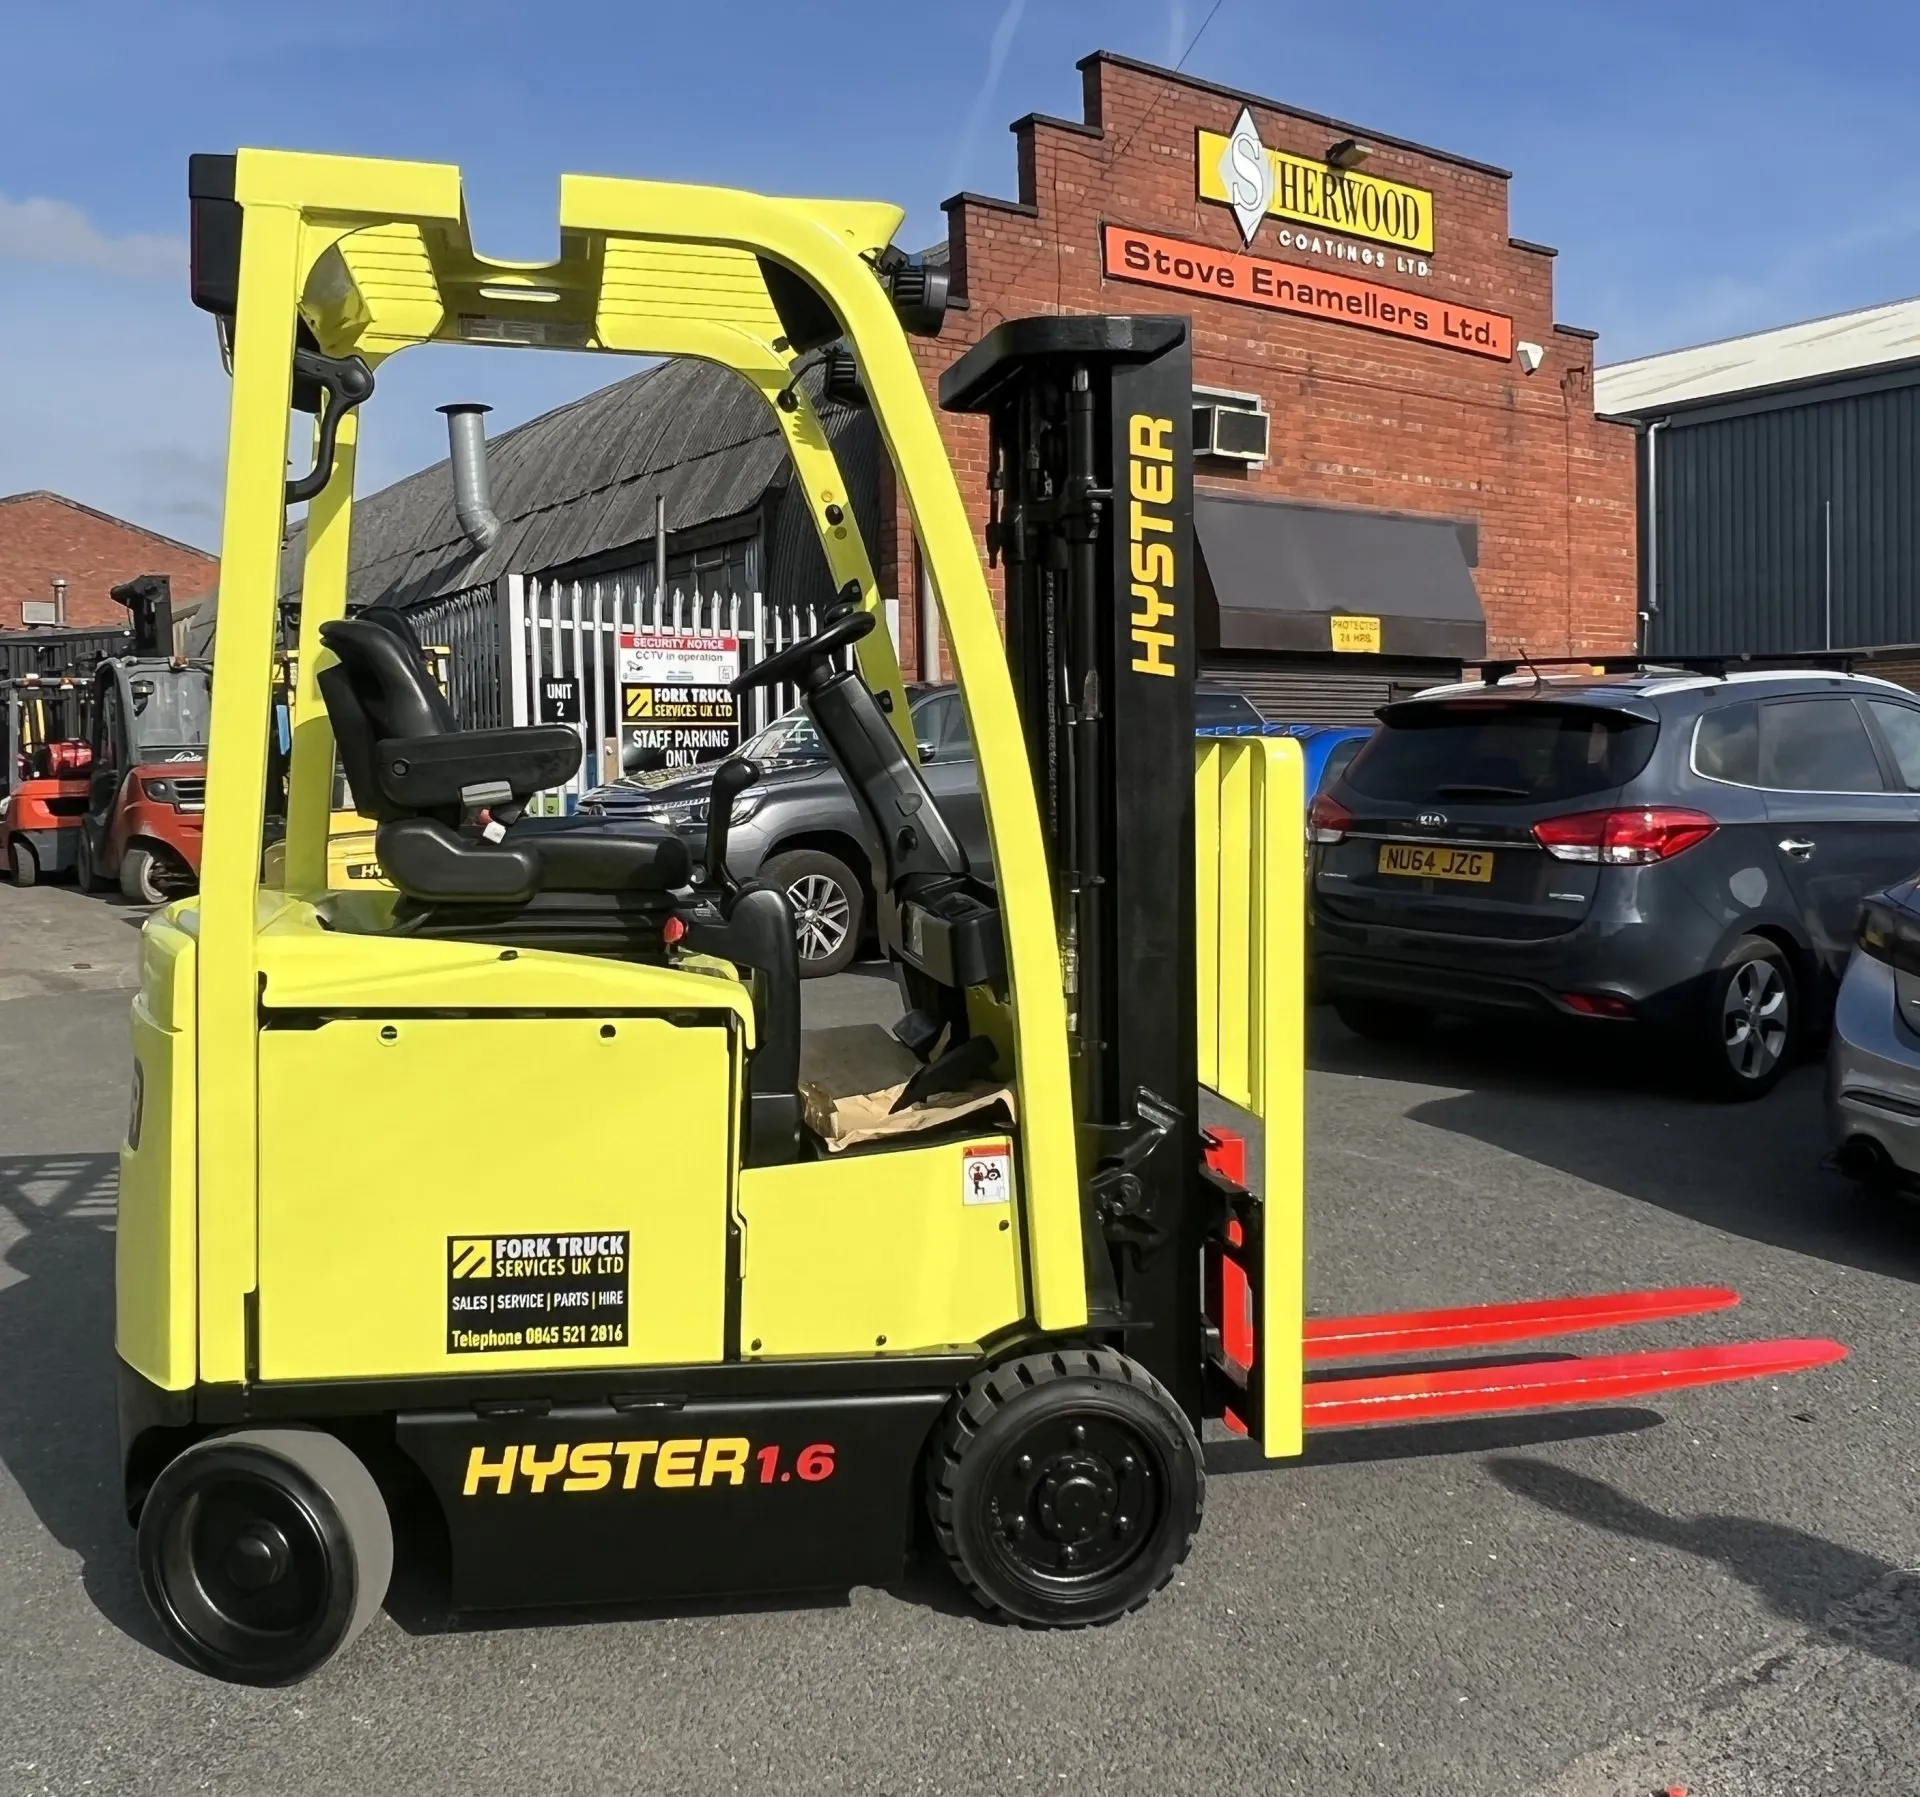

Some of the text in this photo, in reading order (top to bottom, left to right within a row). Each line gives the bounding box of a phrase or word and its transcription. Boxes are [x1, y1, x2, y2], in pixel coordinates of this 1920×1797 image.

[1278, 230, 1430, 278] COATINGS LTD
[1124, 239, 1498, 348] Stove Enamellers Ltd.
[1129, 414, 1176, 678] HYSTER
[633, 637, 725, 650] SECURITY NOTICE
[635, 650, 723, 663] CCTV in operation
[547, 683, 573, 699] UNIT
[654, 687, 689, 703] FORK
[556, 702, 565, 717] 2
[654, 704, 733, 717] SERVICES UK LTD
[632, 729, 729, 750] STAFF PARKING
[665, 749, 699, 768] ONLY
[1419, 815, 1441, 826] KIA
[1386, 848, 1483, 876] NU64 JZG
[495, 1235, 625, 1259] FORK TRUCK
[495, 1256, 624, 1278] SERVICES UK LTD
[452, 1290, 624, 1311] SALES SERVICE PARTS HIRE
[452, 1329, 522, 1351] Telephone
[526, 1325, 559, 1345] 0845
[563, 1325, 586, 1343] 521
[462, 1437, 836, 1497] HYSTER 1.6
